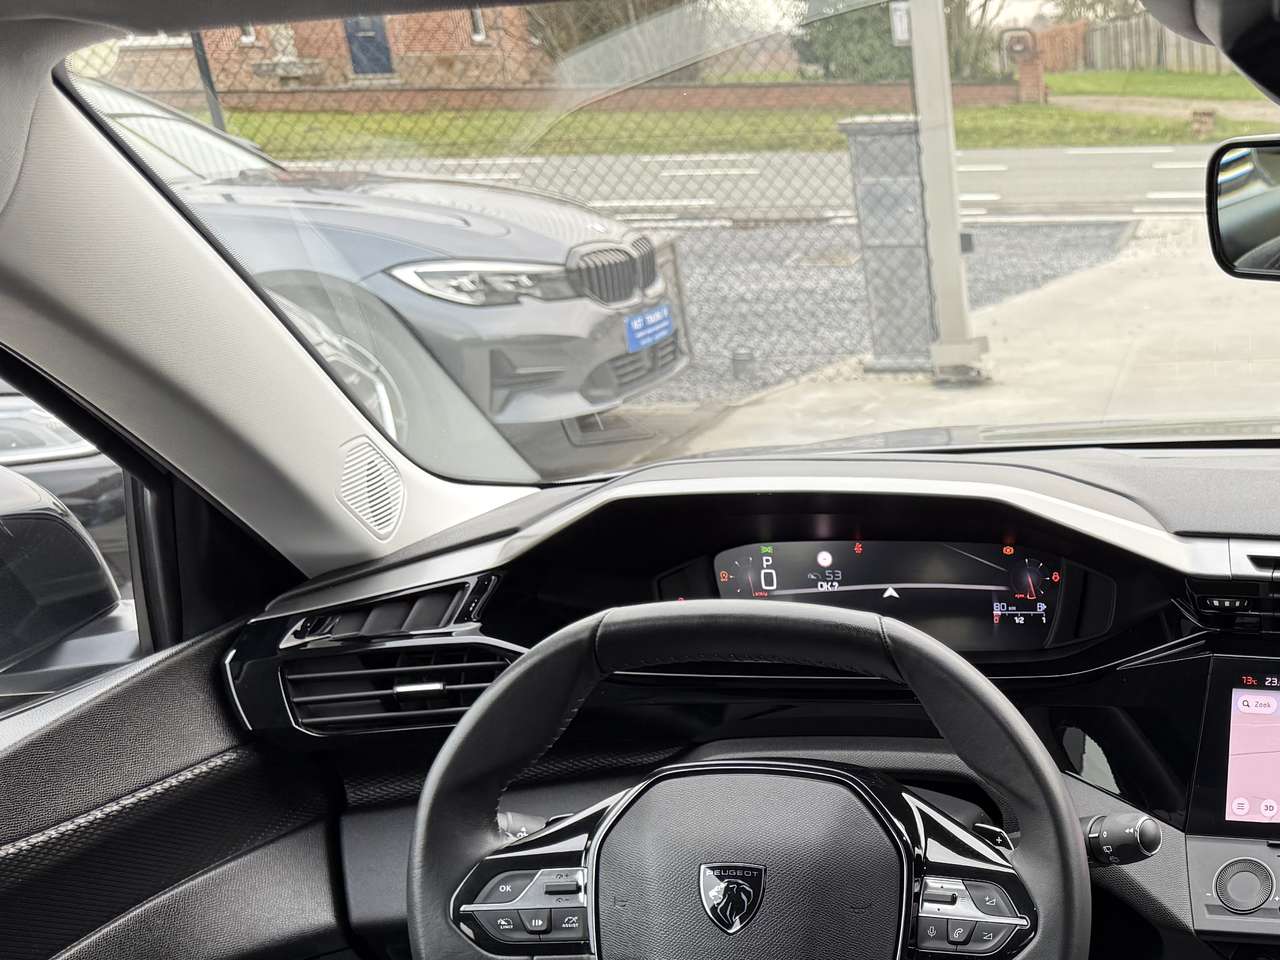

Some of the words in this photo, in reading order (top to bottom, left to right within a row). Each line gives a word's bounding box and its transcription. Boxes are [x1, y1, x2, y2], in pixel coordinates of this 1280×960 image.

[762, 556, 773, 568] P
[706, 869, 759, 877] PEUGEOT
[499, 885, 512, 893] OK
